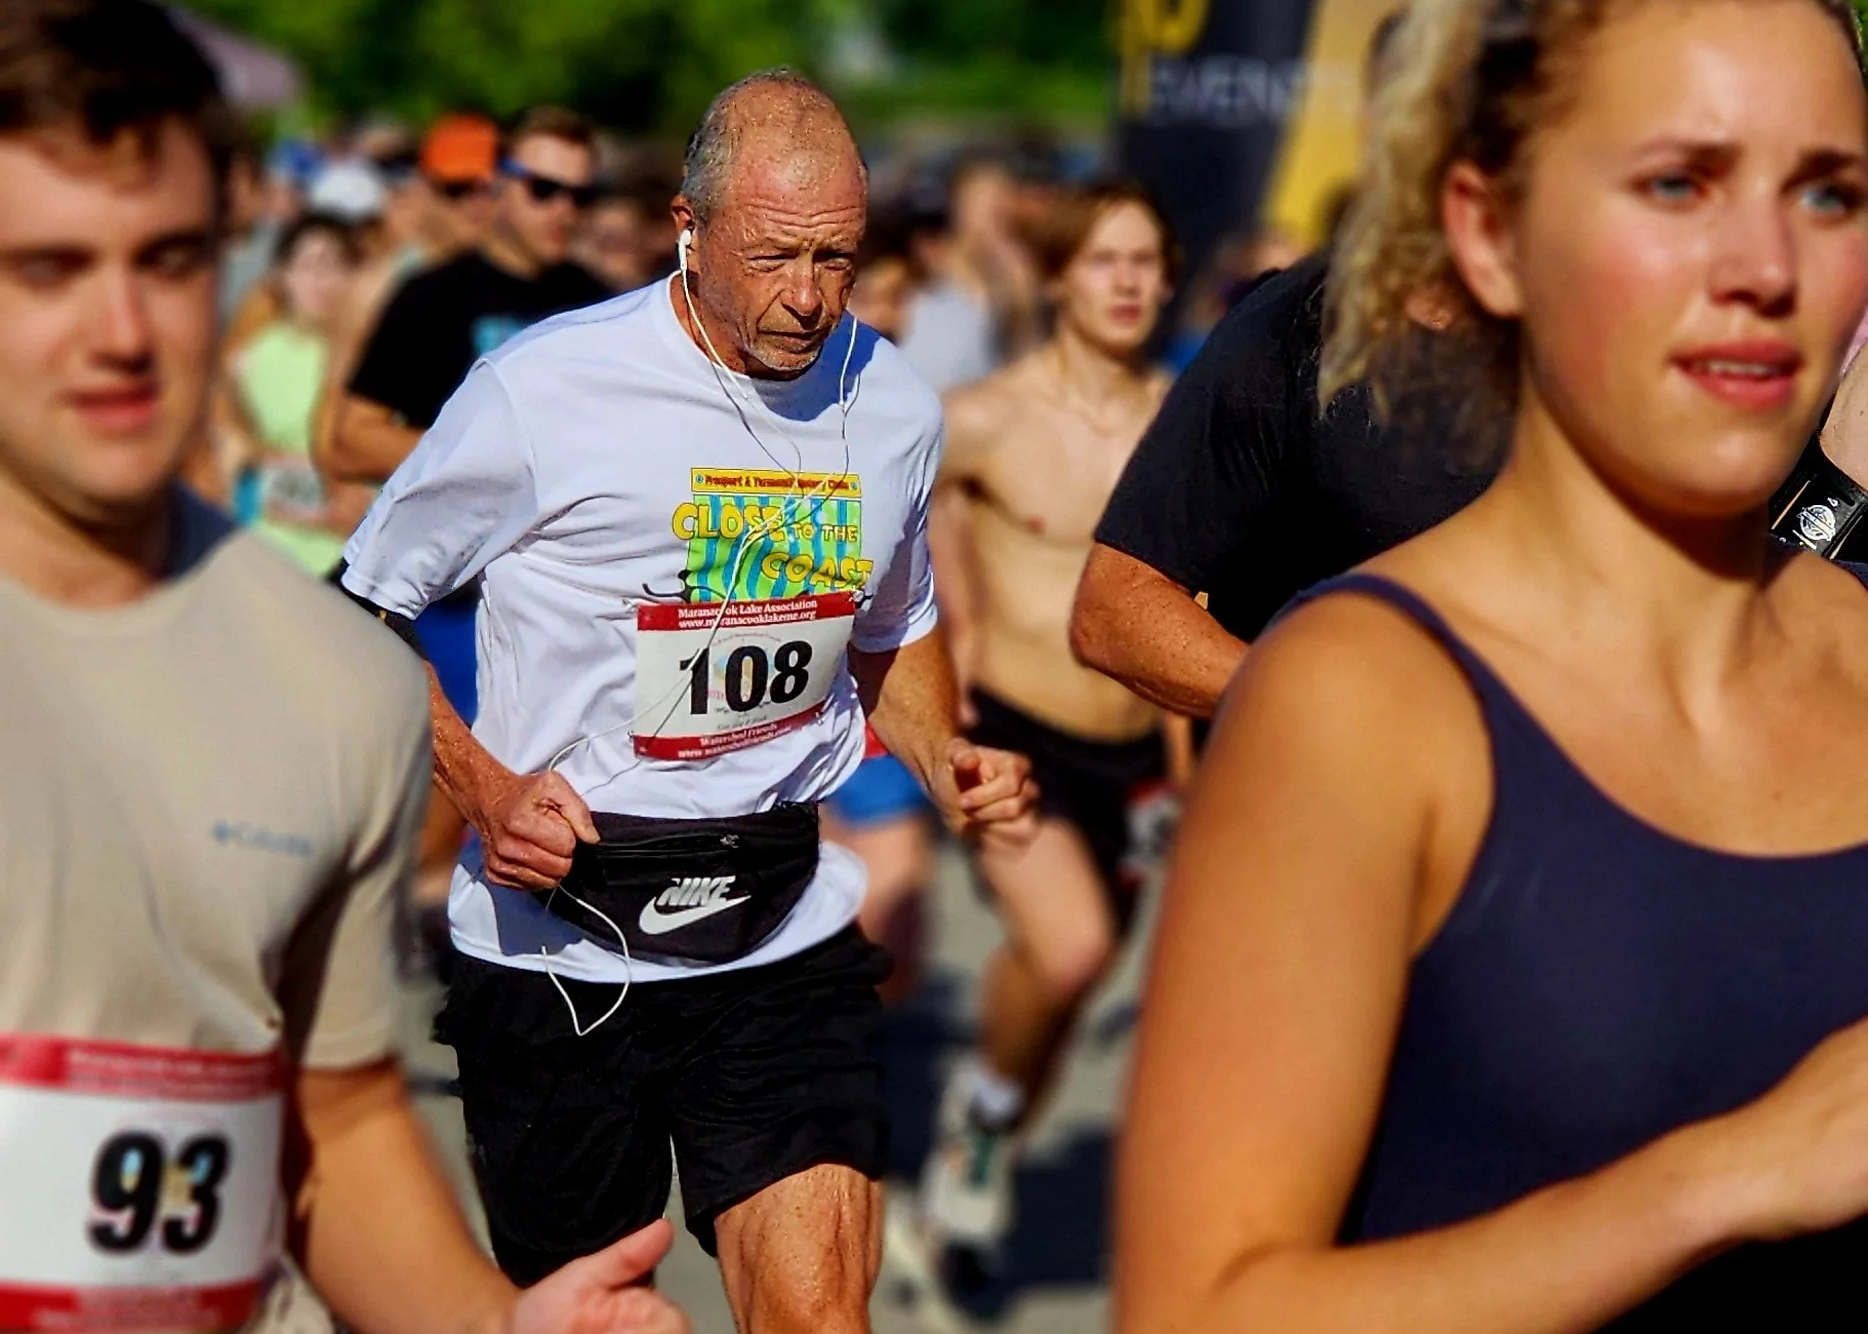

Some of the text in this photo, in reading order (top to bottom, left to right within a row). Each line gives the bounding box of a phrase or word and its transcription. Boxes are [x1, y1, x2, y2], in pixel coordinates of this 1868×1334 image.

[671, 502, 858, 543] CLOSE TO THE
[761, 552, 874, 589] COAST
[678, 598, 818, 618] Maranacok Lake Association
[678, 610, 817, 629] www.mranacooklakeme.org
[680, 641, 812, 715] 108
[655, 875, 736, 907] NIKE
[86, 1129, 232, 1255] 93
